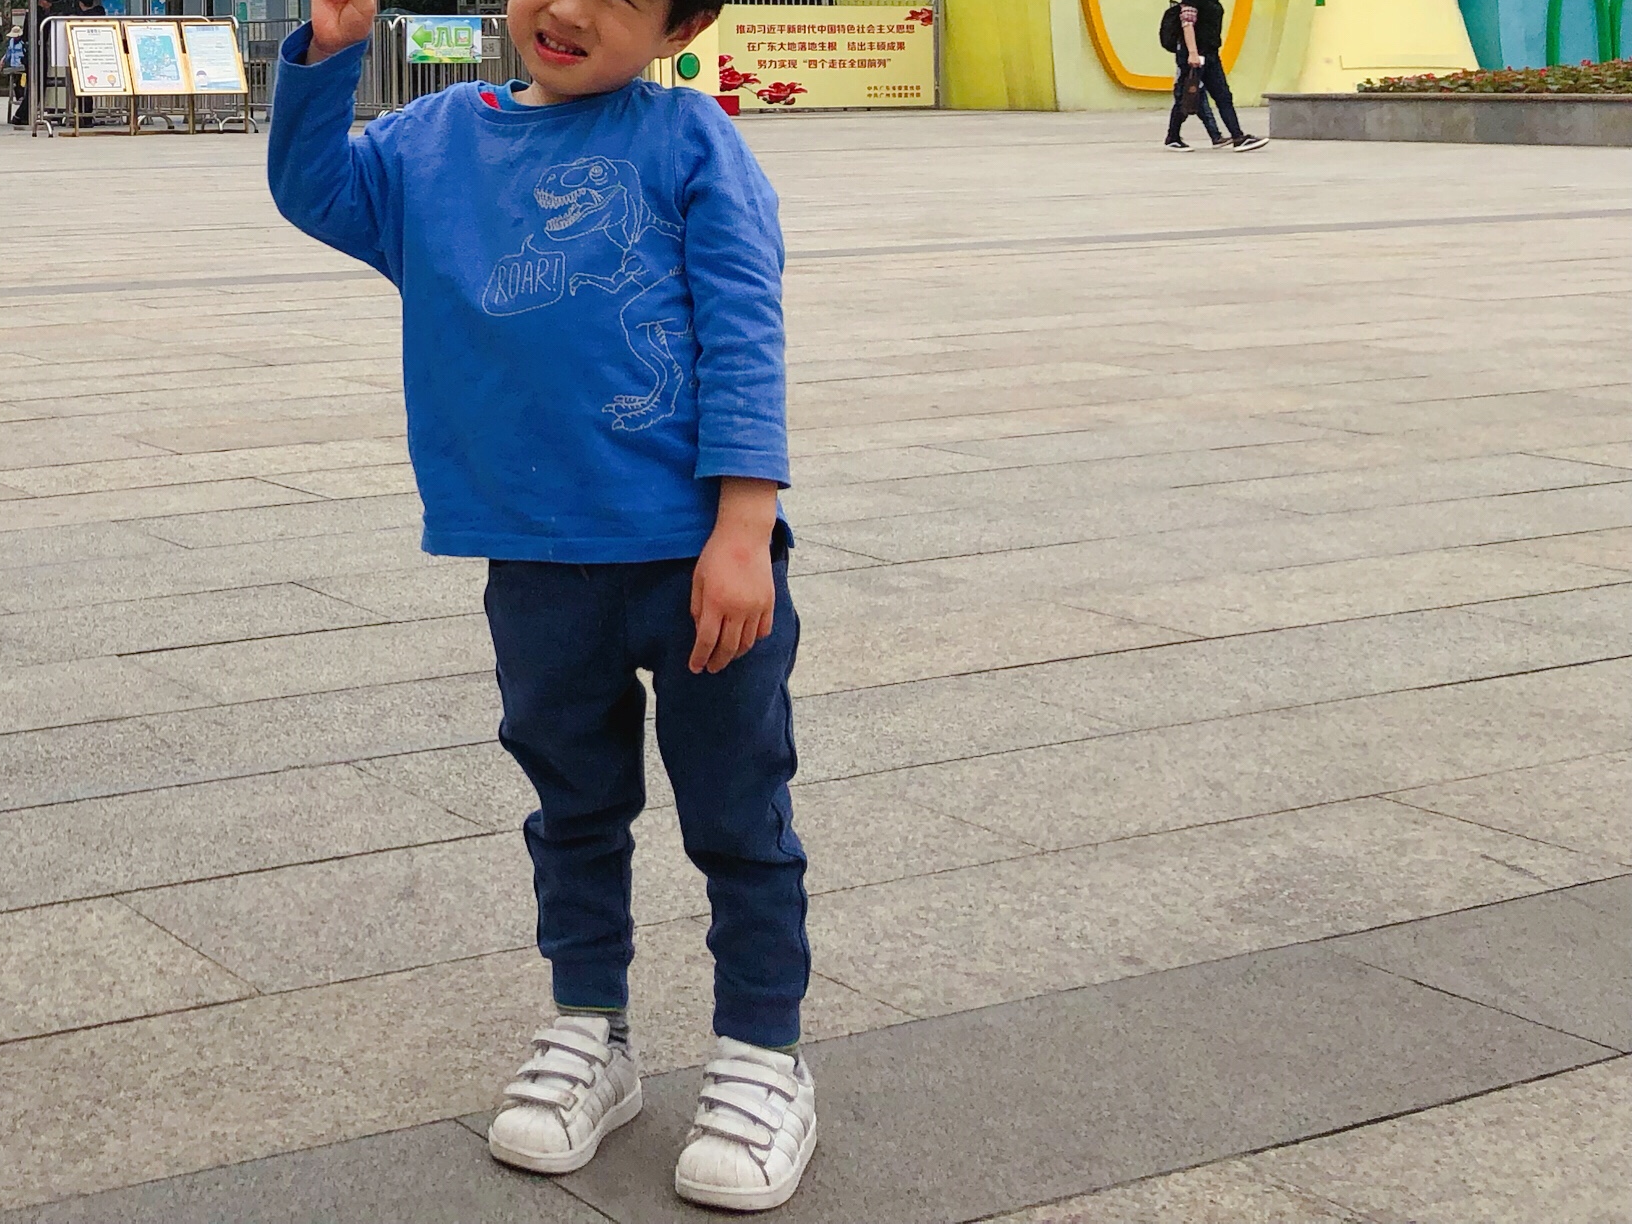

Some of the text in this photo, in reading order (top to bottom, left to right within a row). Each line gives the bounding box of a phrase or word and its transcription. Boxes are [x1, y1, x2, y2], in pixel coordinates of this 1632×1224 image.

[434, 26, 472, 48] 入口
[735, 24, 916, 34] 推动习近平新时代中国特色社会主义思想
[746, 41, 906, 51] 在广东大地落地生根 结出丰硕成果
[494, 258, 561, 304] ROAR!
